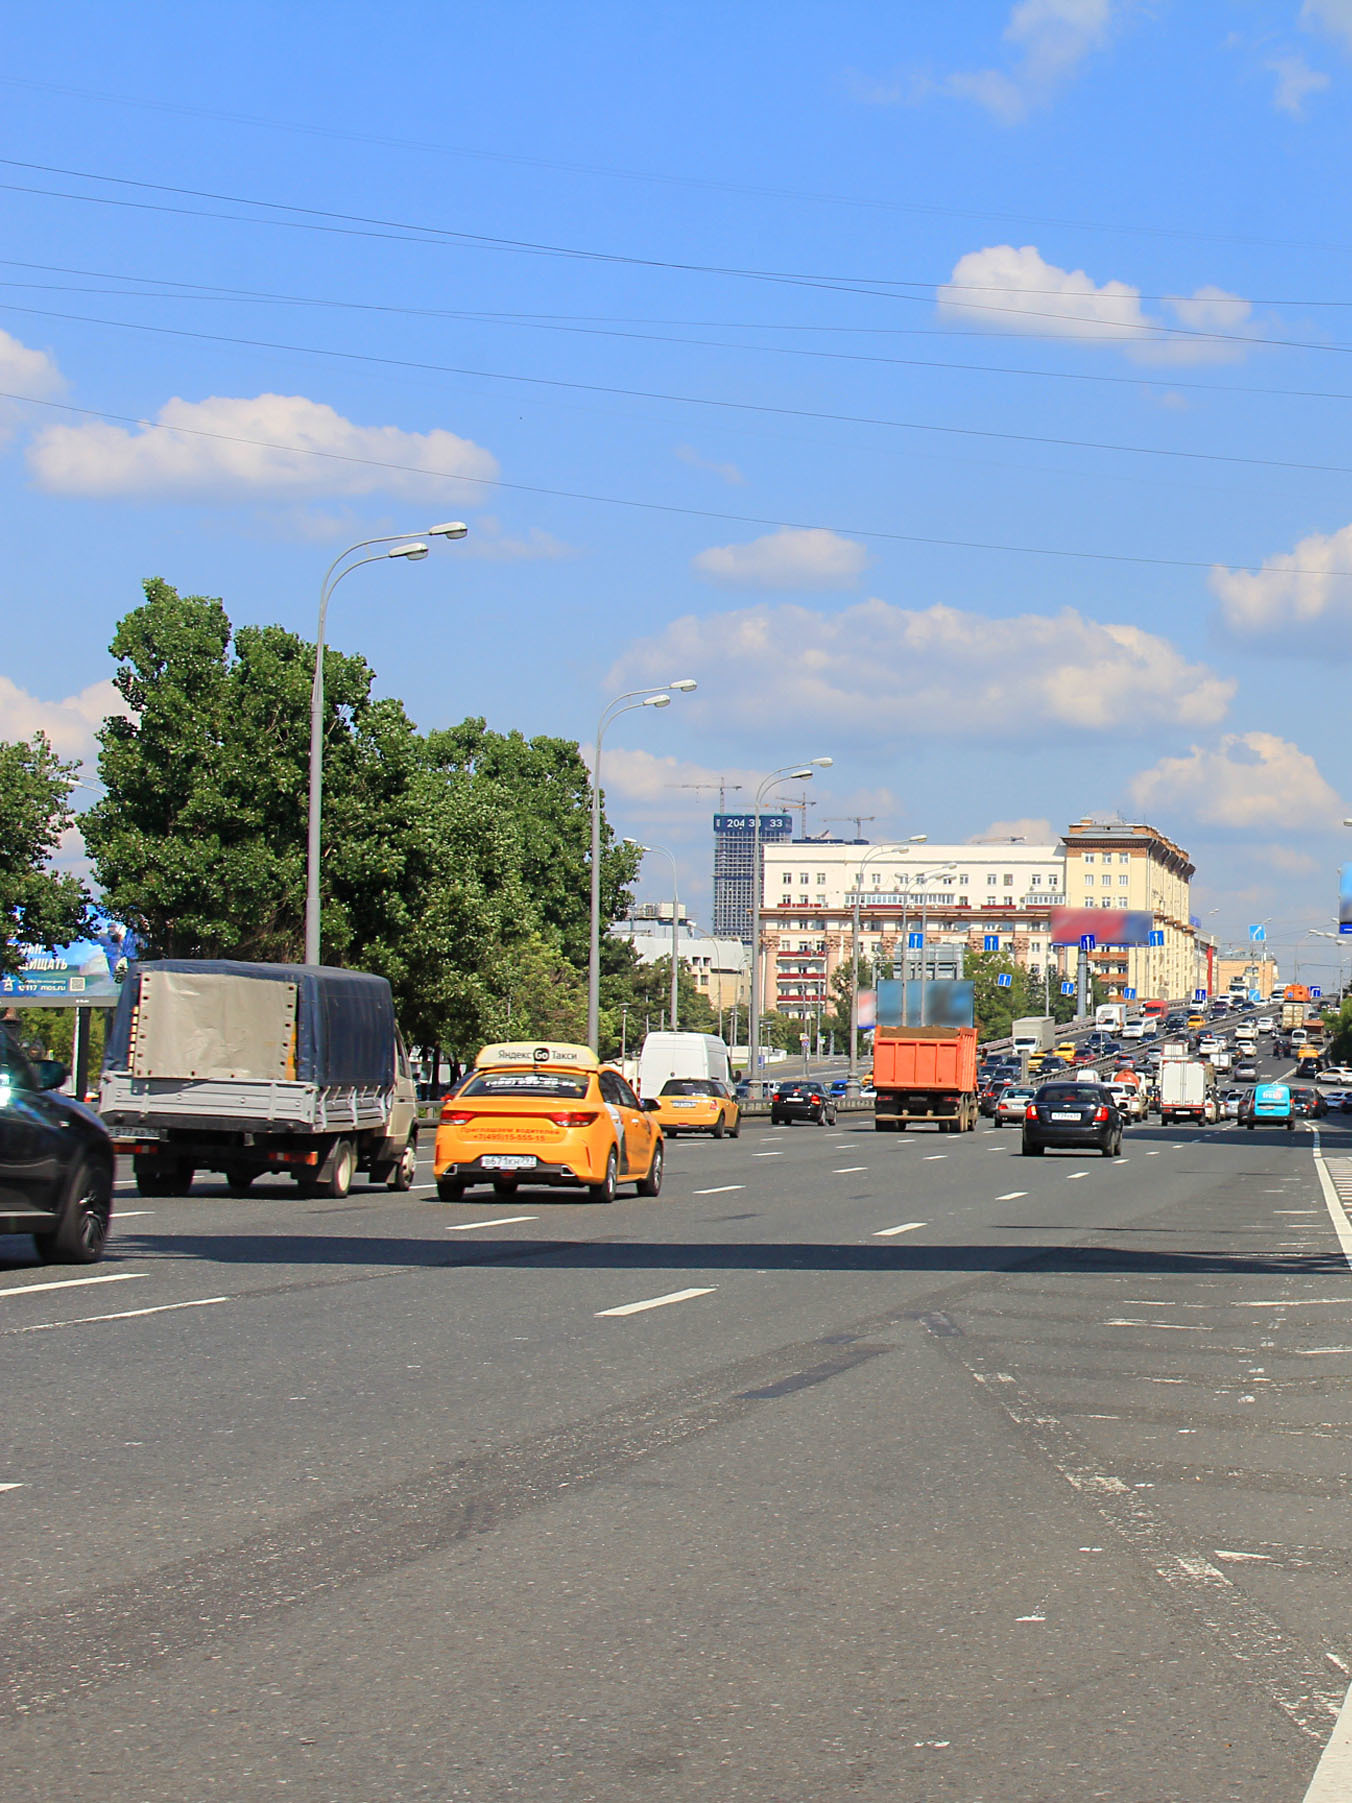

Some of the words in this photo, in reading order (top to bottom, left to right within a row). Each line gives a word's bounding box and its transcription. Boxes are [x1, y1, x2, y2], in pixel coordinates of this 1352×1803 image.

[726, 818, 745, 828] 204
[769, 818, 783, 828] 33
[498, 1050, 532, 1060] Яндекс
[535, 1050, 549, 1060] Go
[552, 1051, 578, 1060] Такси
